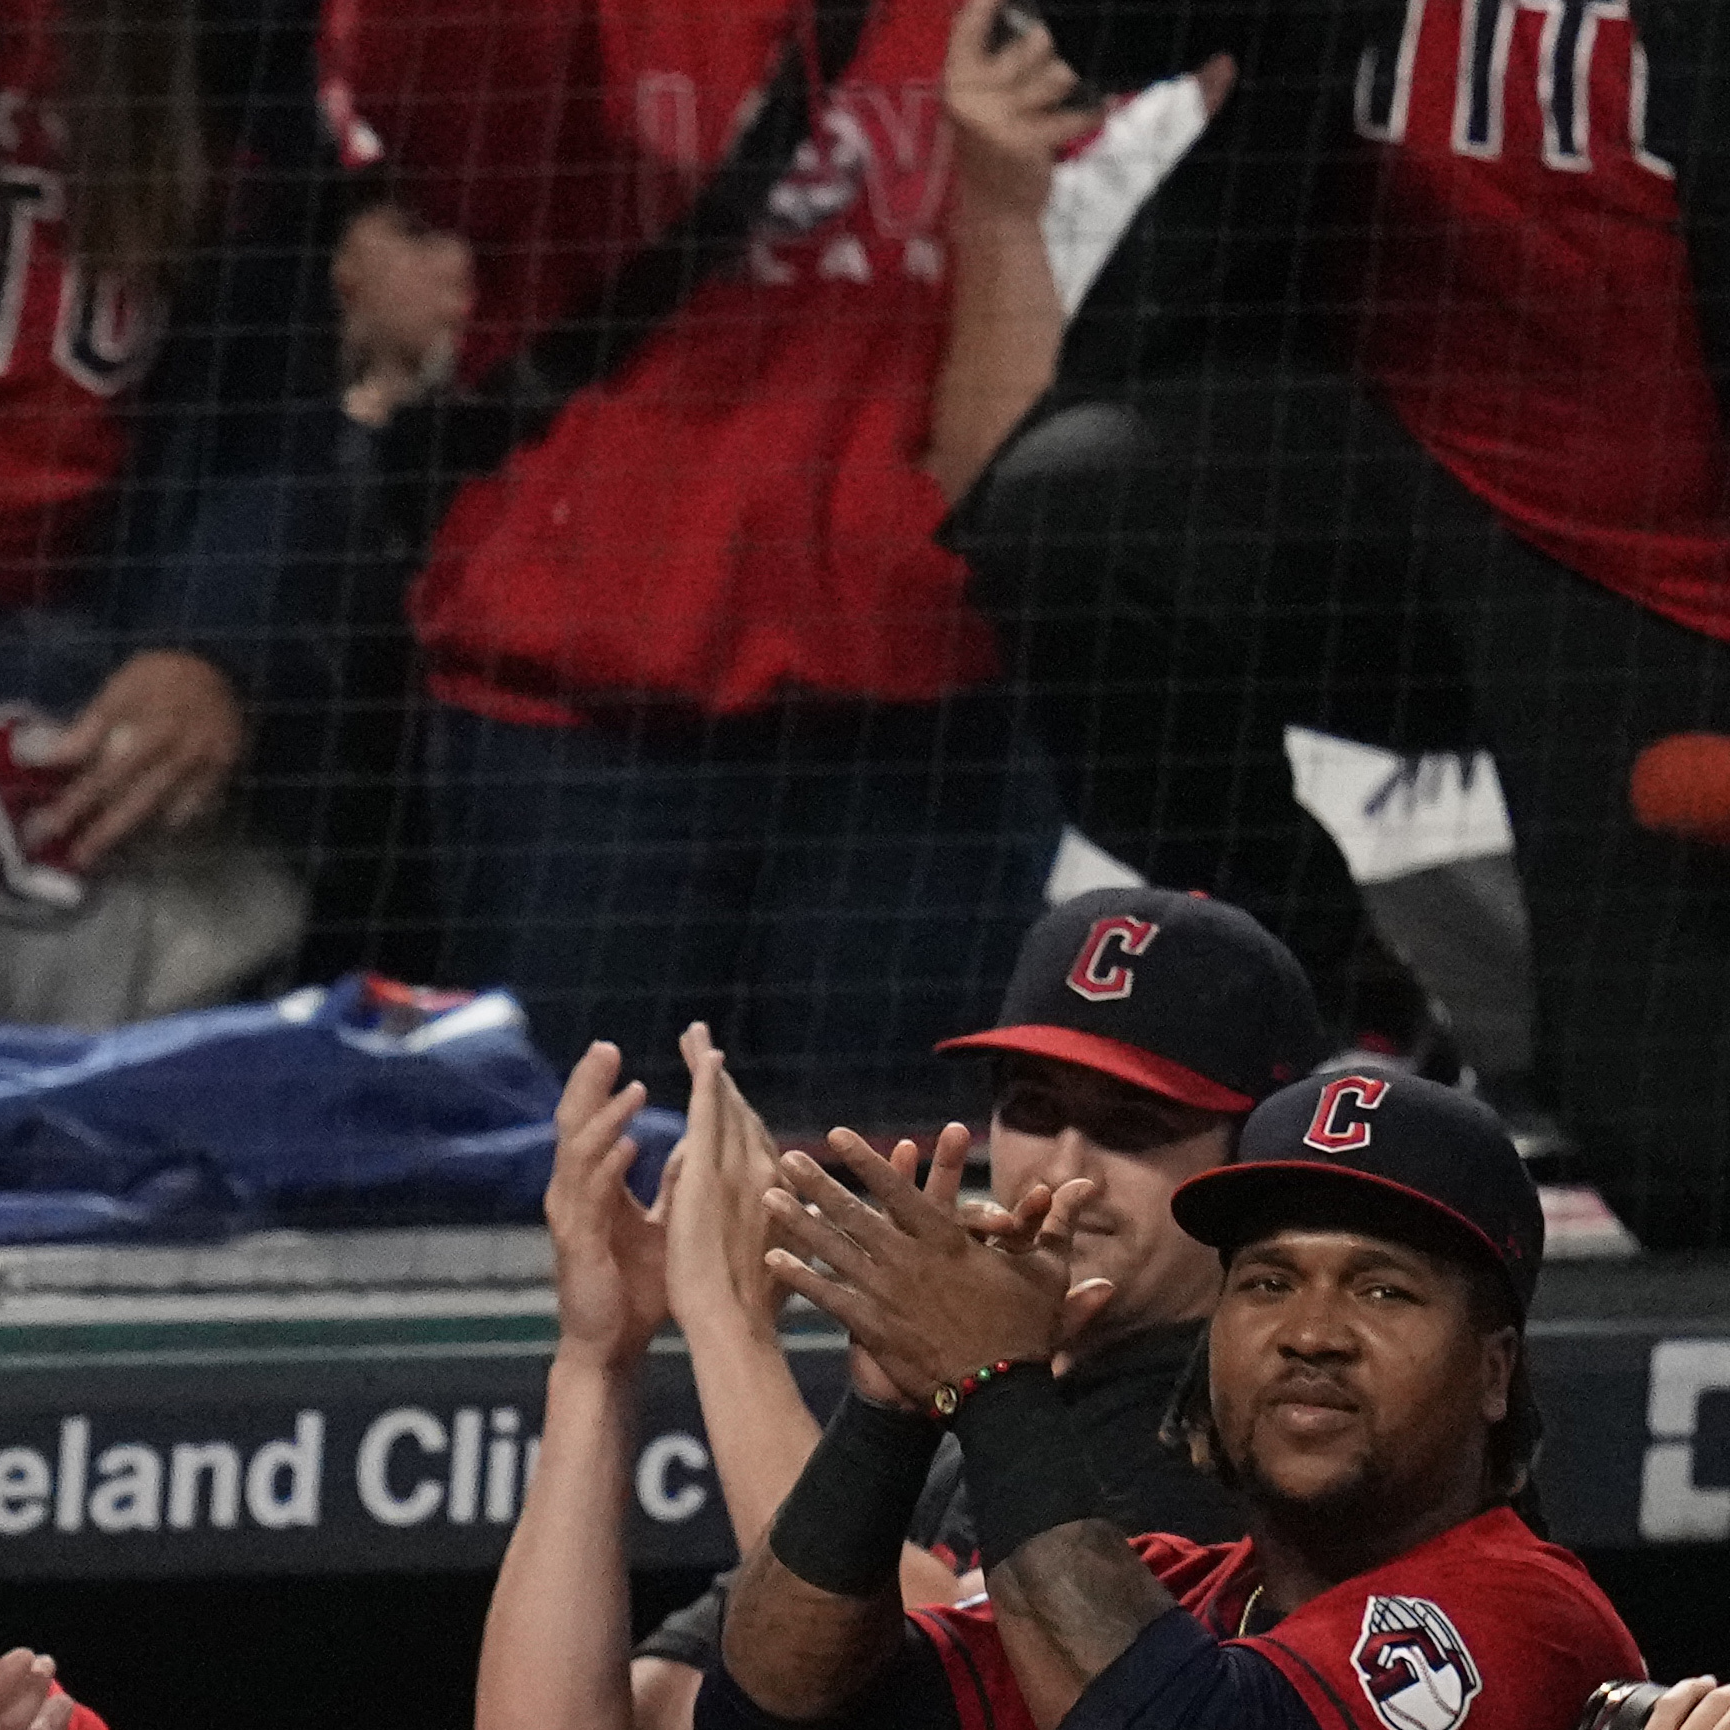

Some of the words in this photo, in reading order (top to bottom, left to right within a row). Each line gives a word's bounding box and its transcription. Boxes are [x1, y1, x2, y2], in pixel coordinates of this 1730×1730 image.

[1064, 913, 1159, 1002] C
[1302, 1073, 1391, 1154] C
[356, 1405, 708, 1528] Clic
